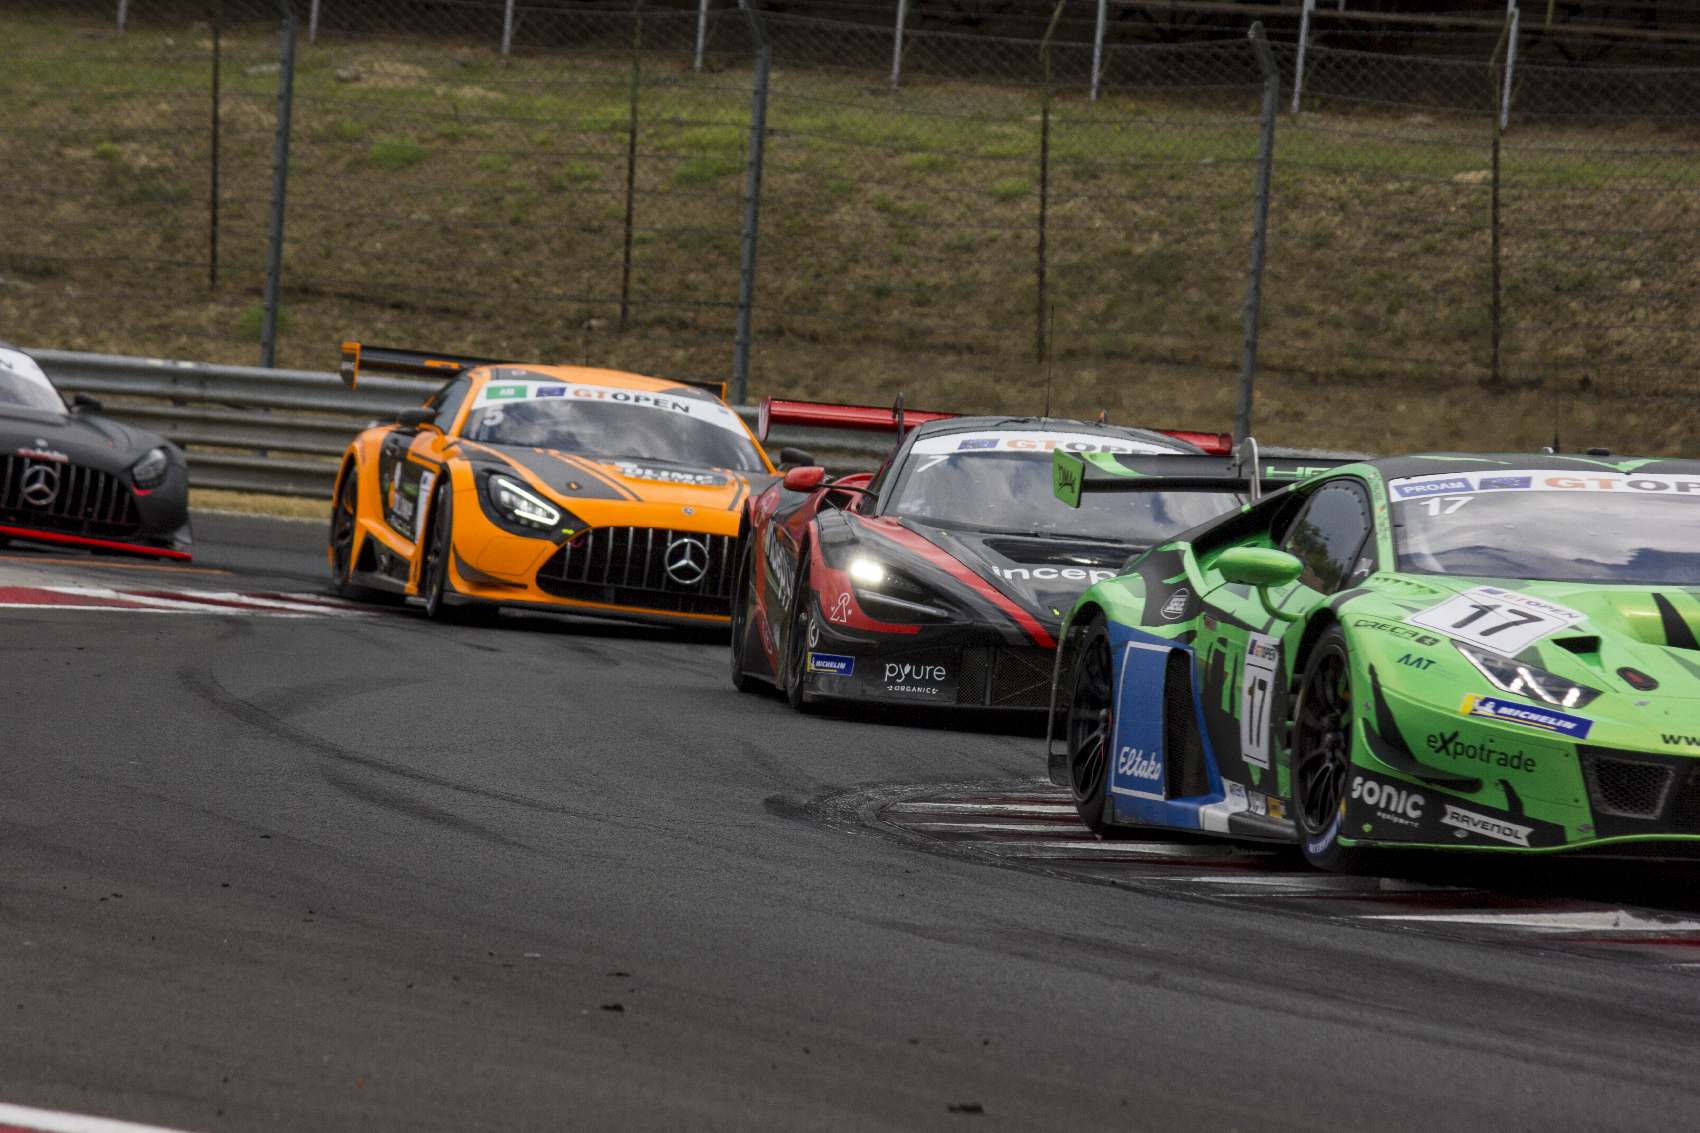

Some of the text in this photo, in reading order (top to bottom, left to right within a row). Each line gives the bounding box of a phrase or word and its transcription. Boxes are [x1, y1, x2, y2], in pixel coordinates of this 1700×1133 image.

[499, 387, 516, 396] AM
[573, 388, 690, 414] GTOPEN
[482, 403, 505, 426] 5
[917, 455, 950, 473] 7
[1405, 480, 1466, 494] PROAM
[1420, 496, 1476, 517] 17
[1451, 604, 1545, 637] 17
[815, 660, 847, 670] MICHELIN
[884, 663, 947, 683] pyure
[1247, 675, 1268, 749] 17
[1497, 705, 1578, 731] MICHELIN
[1118, 746, 1162, 781] Eltako
